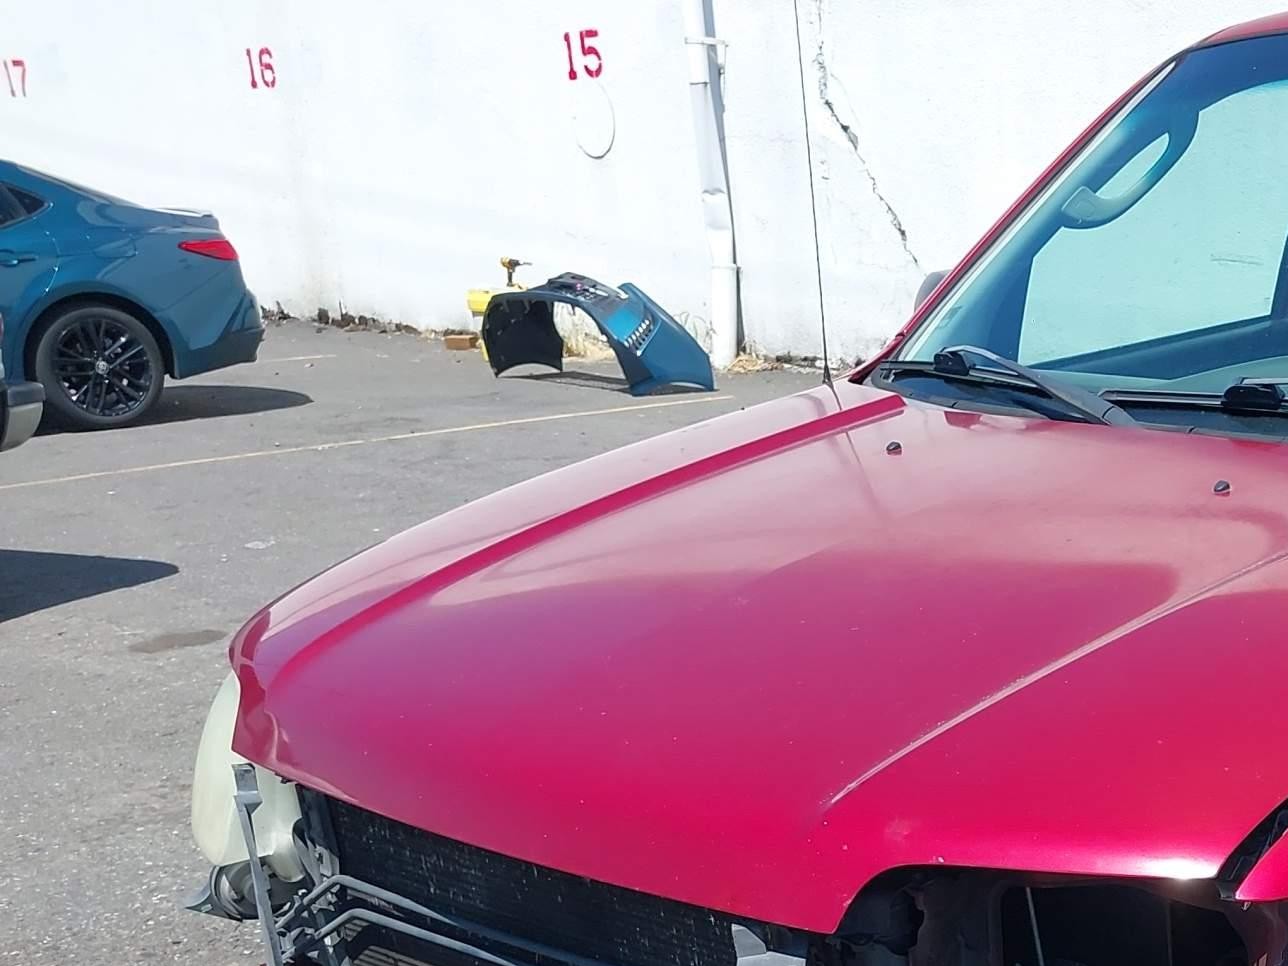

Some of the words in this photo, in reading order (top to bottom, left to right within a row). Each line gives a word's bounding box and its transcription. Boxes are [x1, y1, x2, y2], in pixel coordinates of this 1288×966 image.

[246, 47, 276, 89] 16
[564, 29, 603, 81] 15
[3, 59, 26, 97] 17
